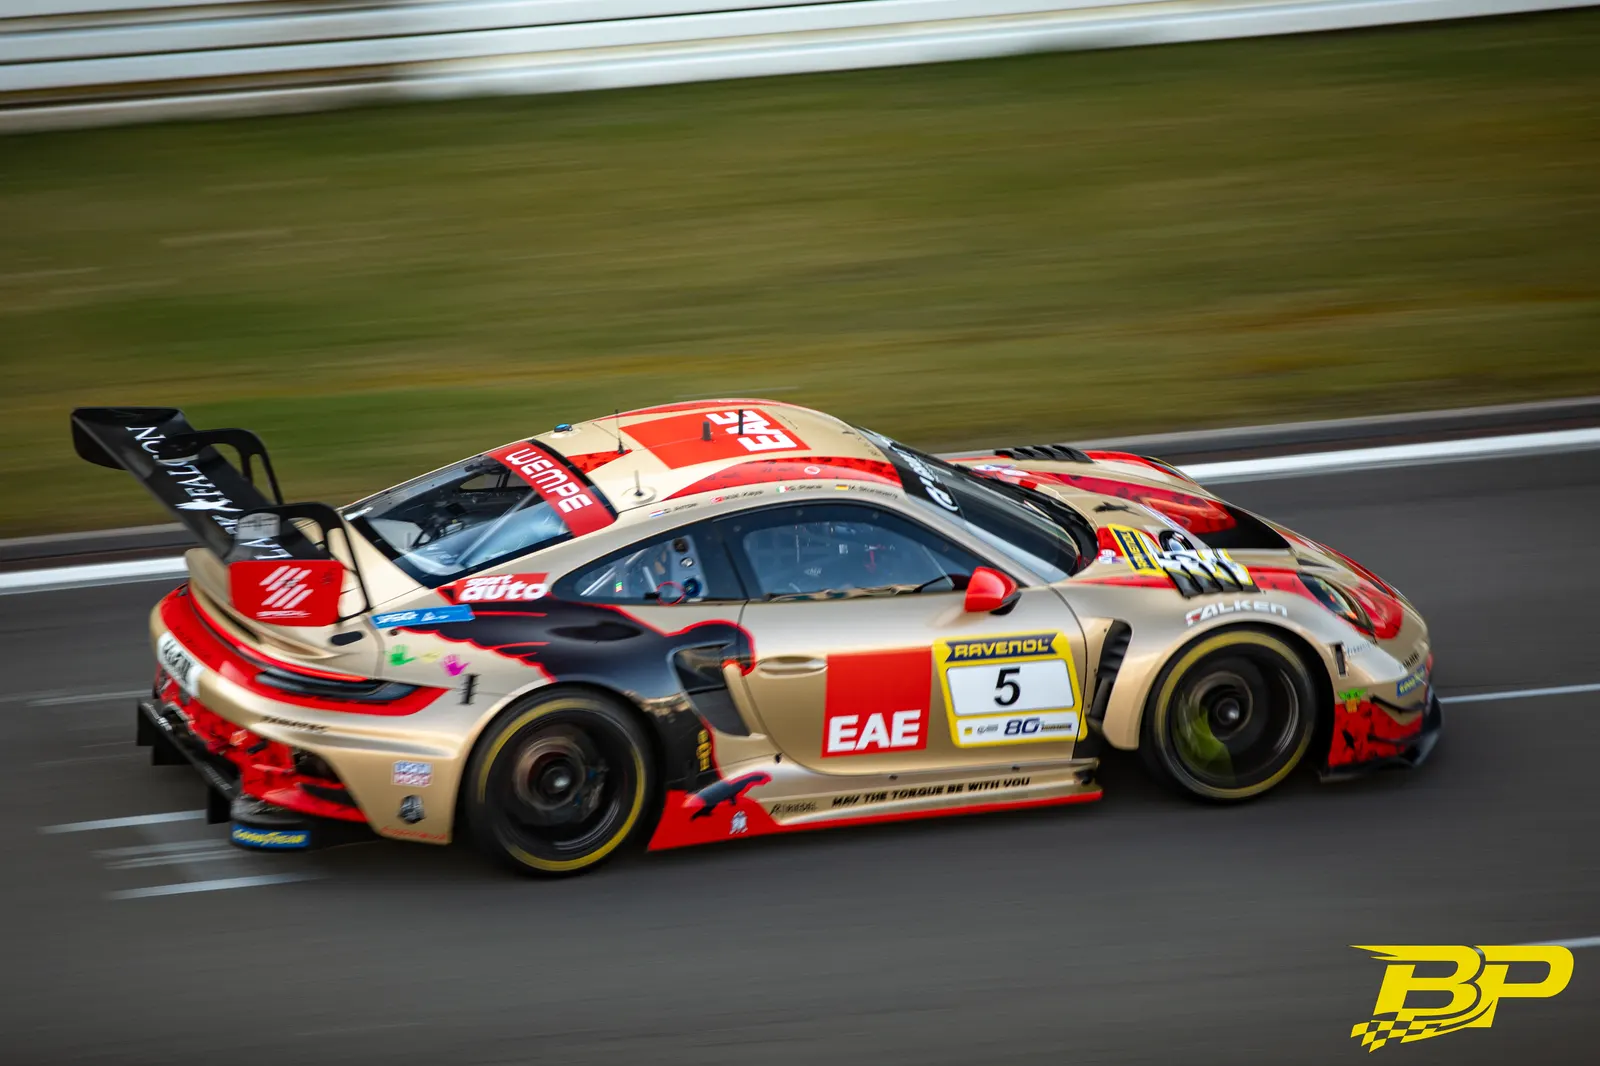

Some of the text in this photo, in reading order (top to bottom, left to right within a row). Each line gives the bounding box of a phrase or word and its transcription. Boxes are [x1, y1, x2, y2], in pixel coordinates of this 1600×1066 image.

[705, 410, 798, 452] EAE
[505, 448, 593, 514] WEMPE
[459, 581, 549, 601] auto
[1185, 599, 1288, 627] FALKEN
[954, 639, 1049, 658] RAVENOL
[994, 667, 1021, 707] 5
[827, 709, 922, 753] EAE
[831, 777, 1031, 808] MAY THE TORQUE BE WITH YOU
